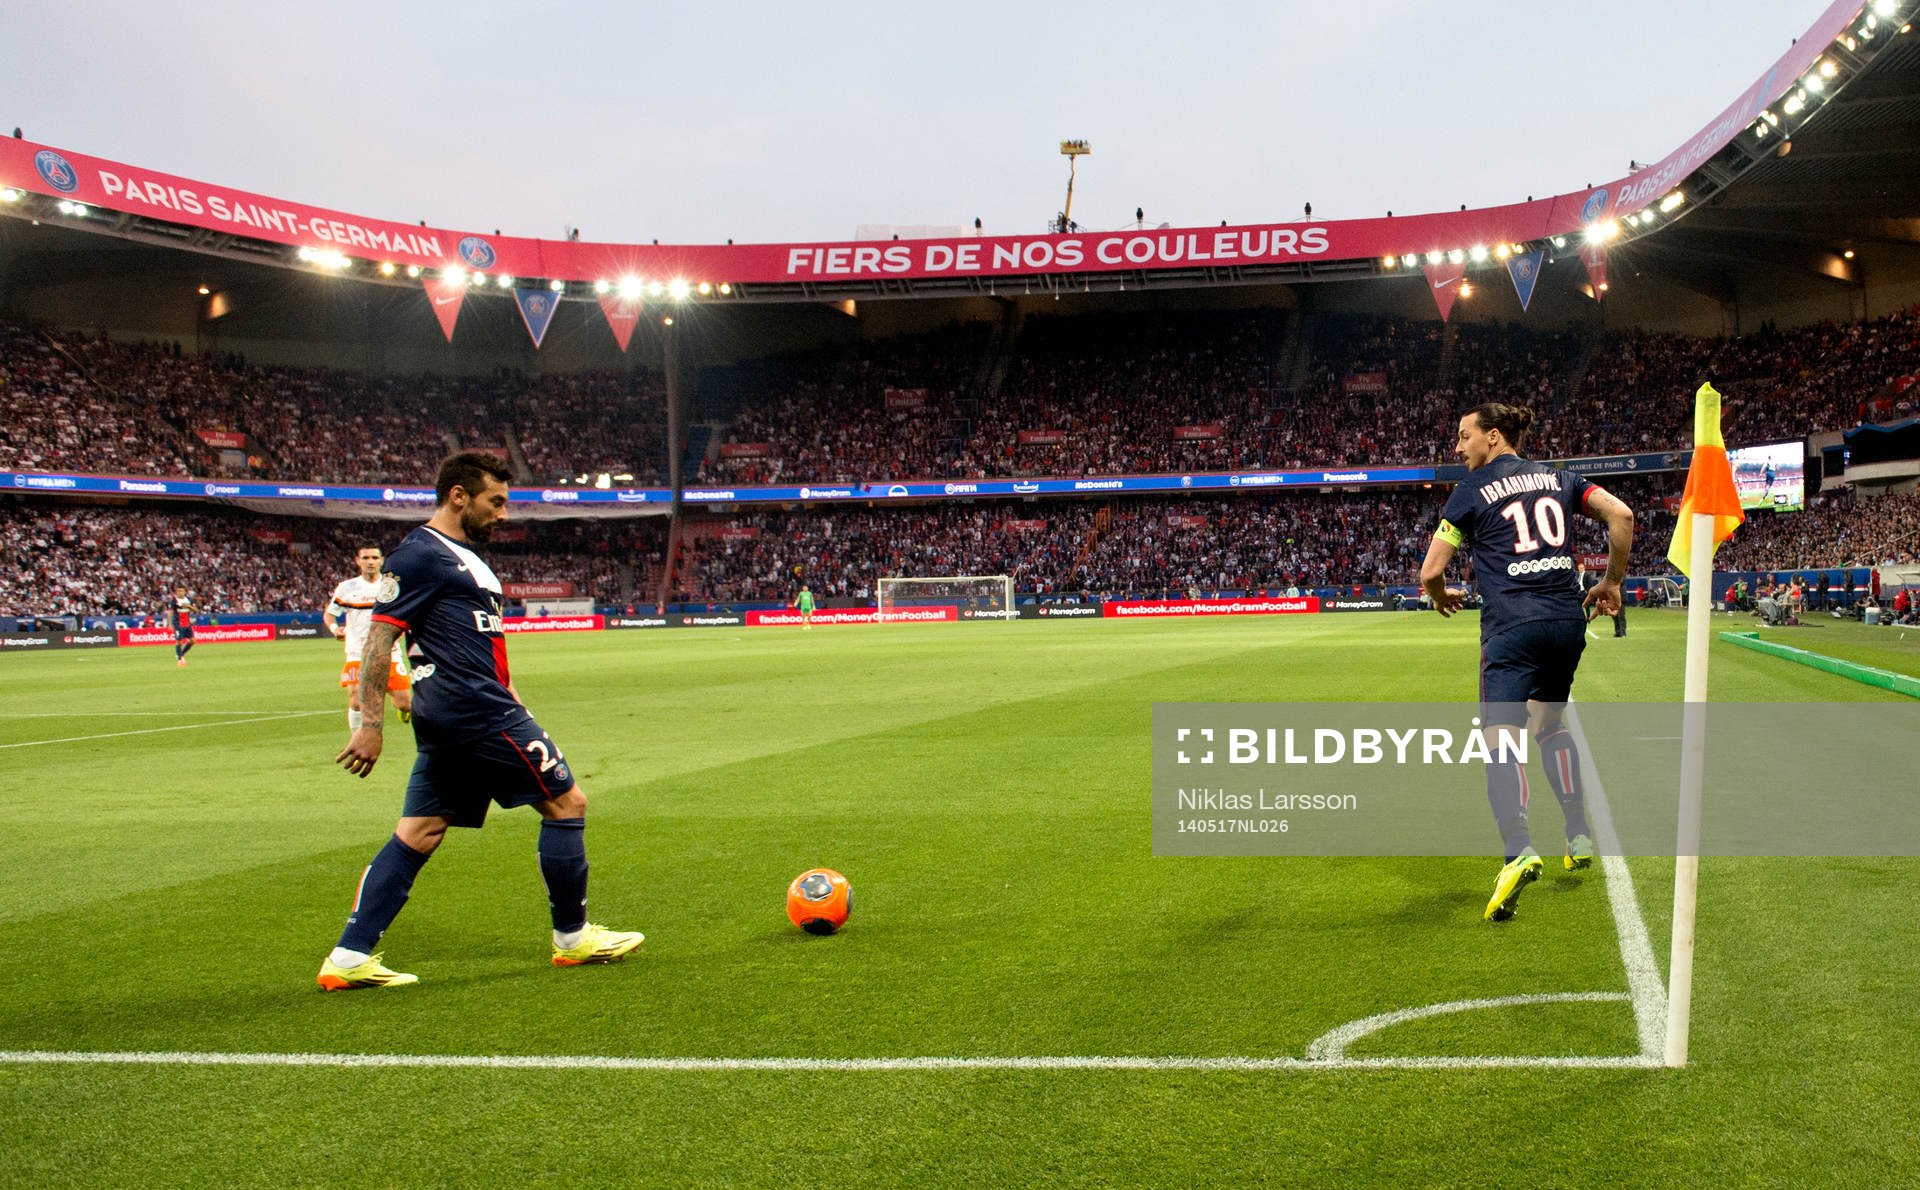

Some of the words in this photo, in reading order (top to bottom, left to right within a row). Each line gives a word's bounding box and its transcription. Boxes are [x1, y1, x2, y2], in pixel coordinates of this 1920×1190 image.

[98, 170, 204, 215] PARIS
[206, 196, 442, 258] SAINT-GERMAIN
[787, 245, 912, 275] FIERS
[925, 244, 982, 271] DE
[992, 240, 1084, 269] NOS
[1096, 227, 1330, 265] COULEURS
[1323, 472, 1368, 482] Panasonic
[120, 480, 167, 492] Panasonic
[1075, 480, 1123, 489] McDonald's
[1479, 472, 1562, 505] IBRAHIMOVIĆ
[684, 491, 735, 500] McDonald's
[811, 489, 851, 498] MoneyGram
[1501, 496, 1566, 554] 10
[511, 585, 525, 595] Fly
[526, 584, 563, 593] Emirates
[1116, 601, 1307, 615] facebook.com/MoneyGramFootball
[1336, 601, 1383, 609] MoneyGram
[1049, 608, 1096, 616] MoneyGram
[502, 619, 593, 632] neyGramFootball
[620, 618, 666, 627] MoneyGram
[693, 617, 739, 625] MoneyGram
[5, 638, 48, 646] MoneyGram
[73, 635, 113, 644] MoneyGram
